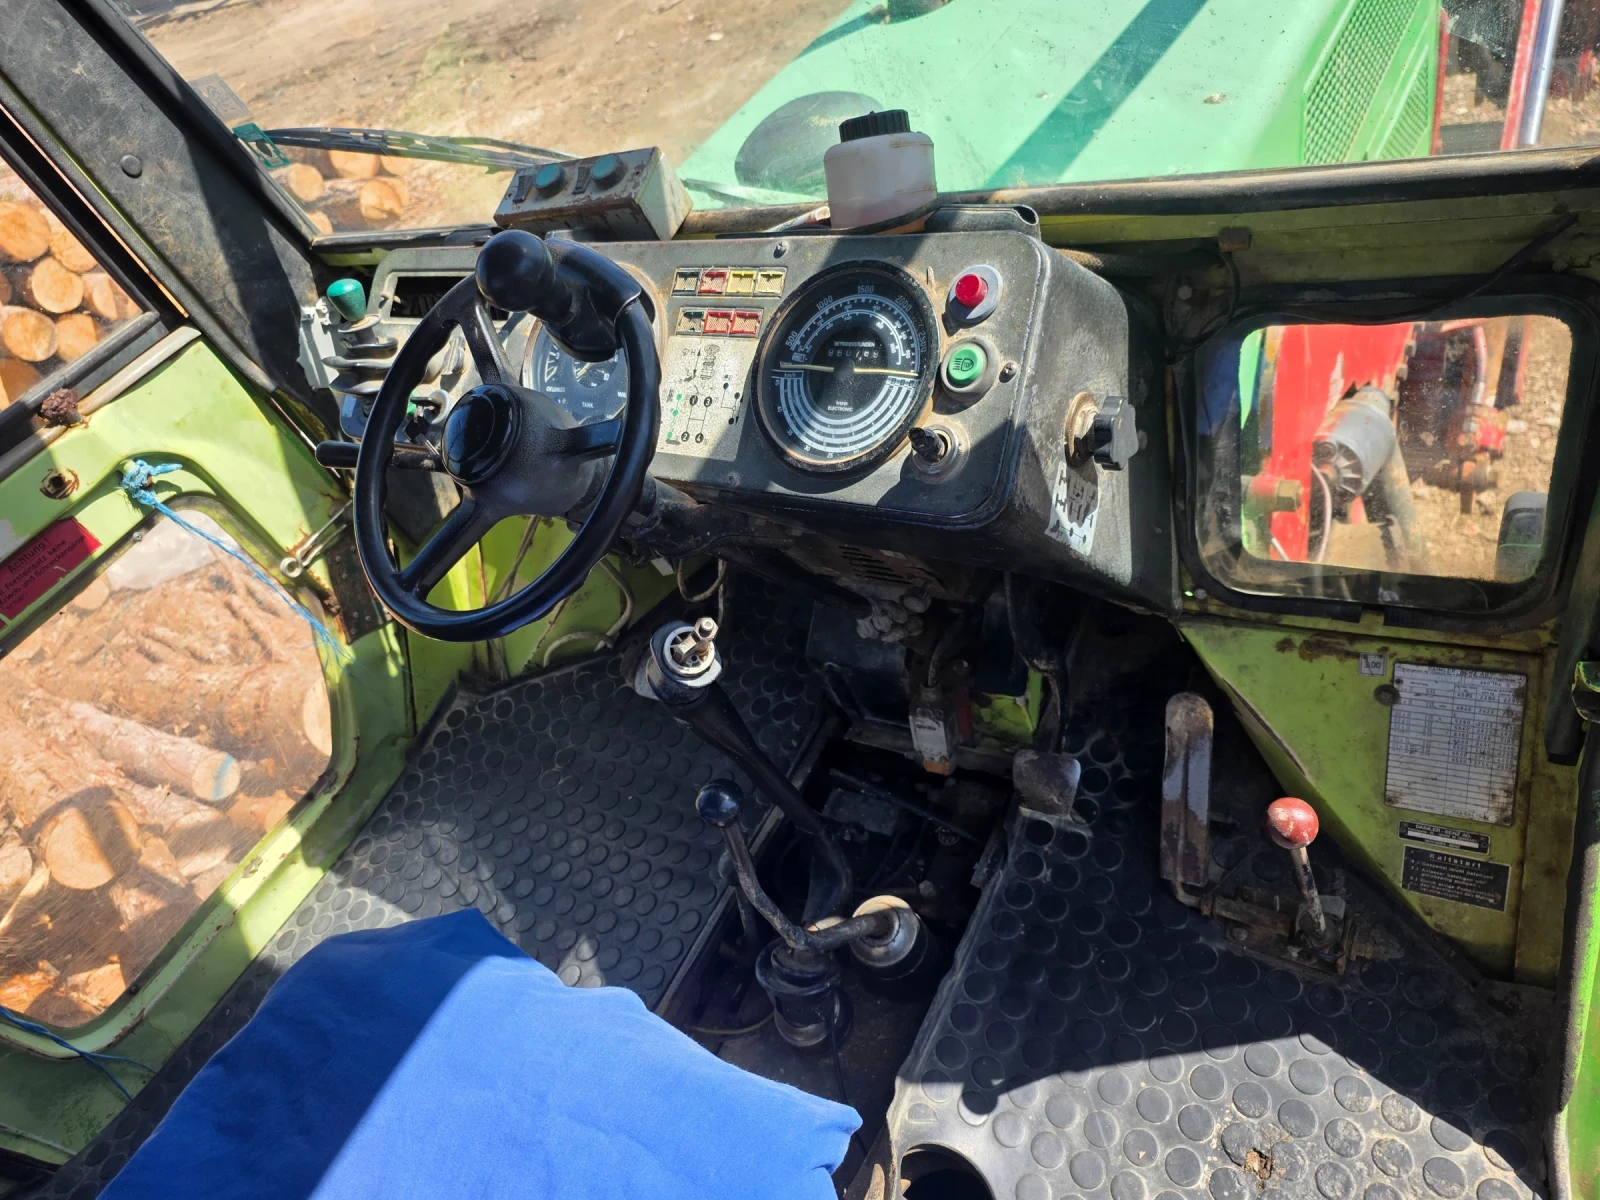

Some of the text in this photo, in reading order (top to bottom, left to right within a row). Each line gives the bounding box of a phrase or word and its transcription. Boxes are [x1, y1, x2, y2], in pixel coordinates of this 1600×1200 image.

[857, 285, 875, 294] 1500
[815, 295, 834, 311] 1000
[894, 295, 912, 312] 2000
[785, 330, 798, 348] 500
[581, 401, 595, 409] TANK
[4, 555, 48, 590] Forsteinsatz
[46, 539, 67, 556] keine
[7, 541, 46, 573] Achtung
[22, 575, 36, 588] und
[1415, 824, 1441, 833] DAIMLER
